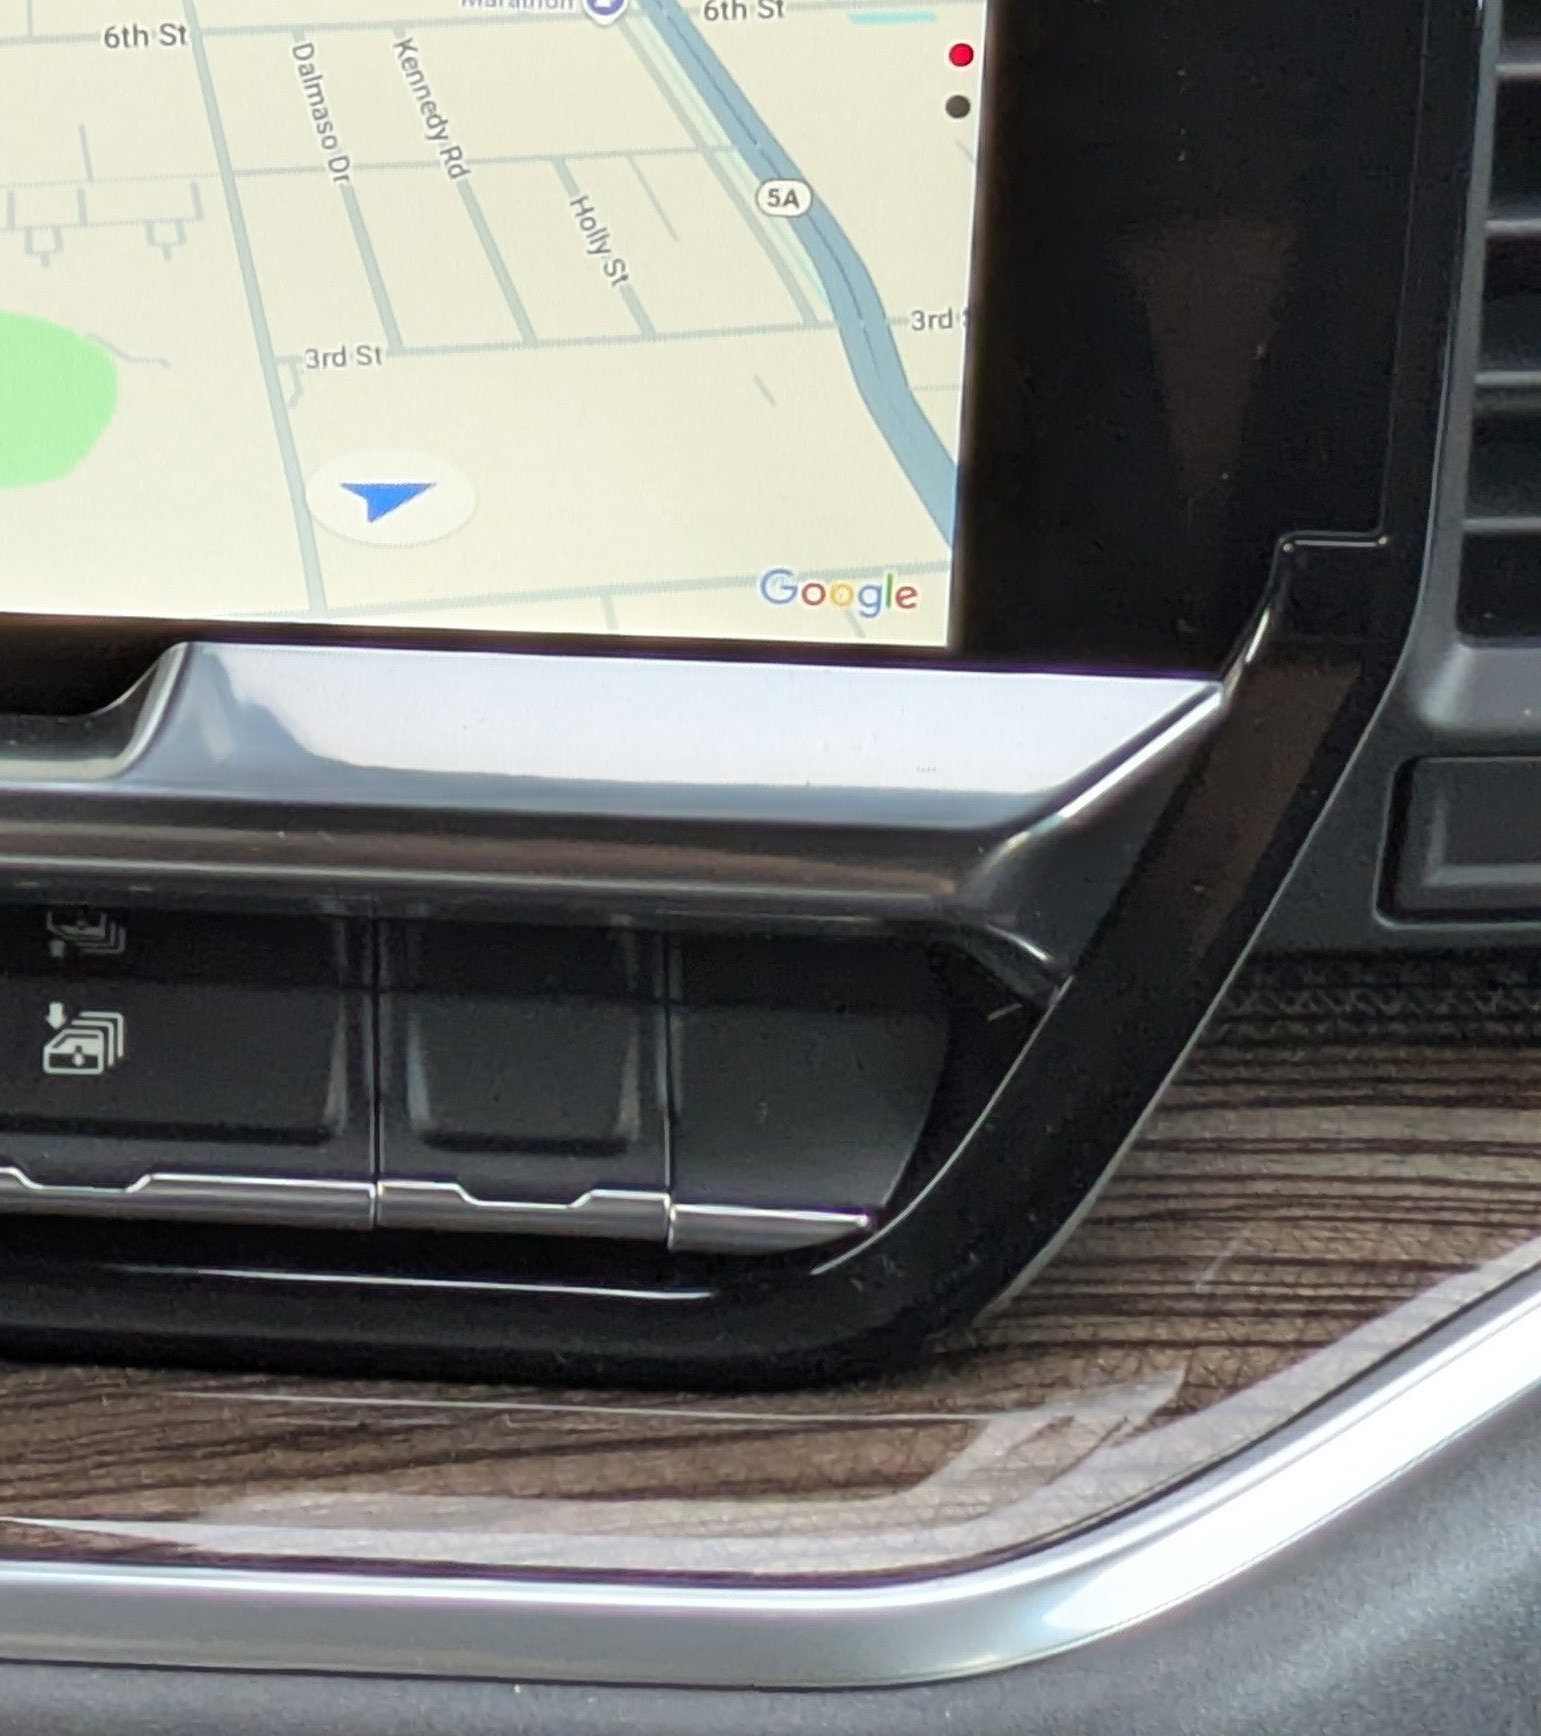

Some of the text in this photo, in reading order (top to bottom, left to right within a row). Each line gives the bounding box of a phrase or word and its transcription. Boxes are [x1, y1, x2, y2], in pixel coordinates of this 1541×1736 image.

[102, 22, 190, 50] 6th St
[291, 41, 352, 185] Dalmaso Dr
[392, 36, 473, 181] Kennedy Rd
[765, 187, 801, 209] 5A
[569, 194, 630, 288] Holly St
[910, 305, 954, 332] 3rd
[303, 343, 384, 370] 3rd St
[758, 567, 918, 619] Google
